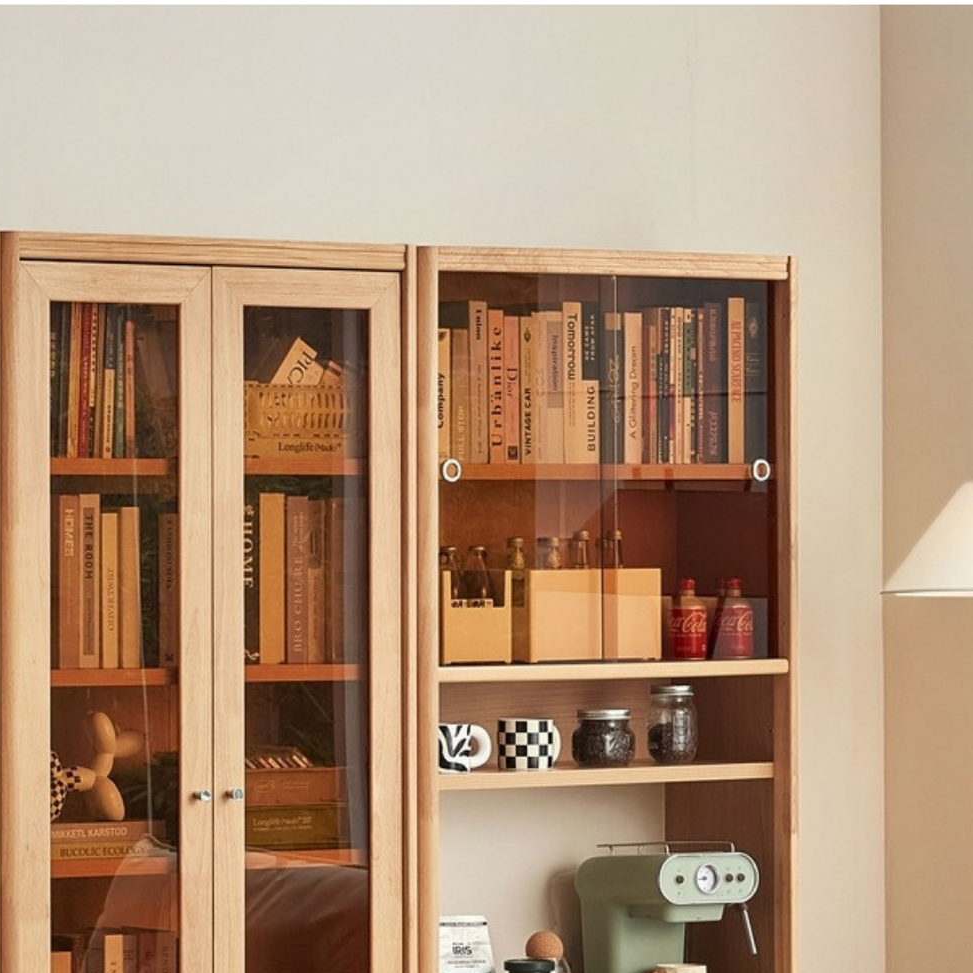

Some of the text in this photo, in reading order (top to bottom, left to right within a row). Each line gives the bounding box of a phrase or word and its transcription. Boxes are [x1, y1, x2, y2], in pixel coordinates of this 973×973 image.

[567, 313, 578, 381] Tomorrow
[629, 346, 637, 380] Dream
[438, 372, 446, 429] Company
[587, 385, 596, 452] BUILDING
[278, 442, 314, 454] Longlife
[629, 430, 636, 439] A
[65, 508, 74, 557] HOMES
[84, 514, 94, 580] THE ROOM
[244, 521, 254, 588] HOME
[106, 568, 115, 632] OLIVER TWIST
[59, 845, 145, 857] BUCOLIC ECOLOGY
[452, 946, 473, 955] IRIS
